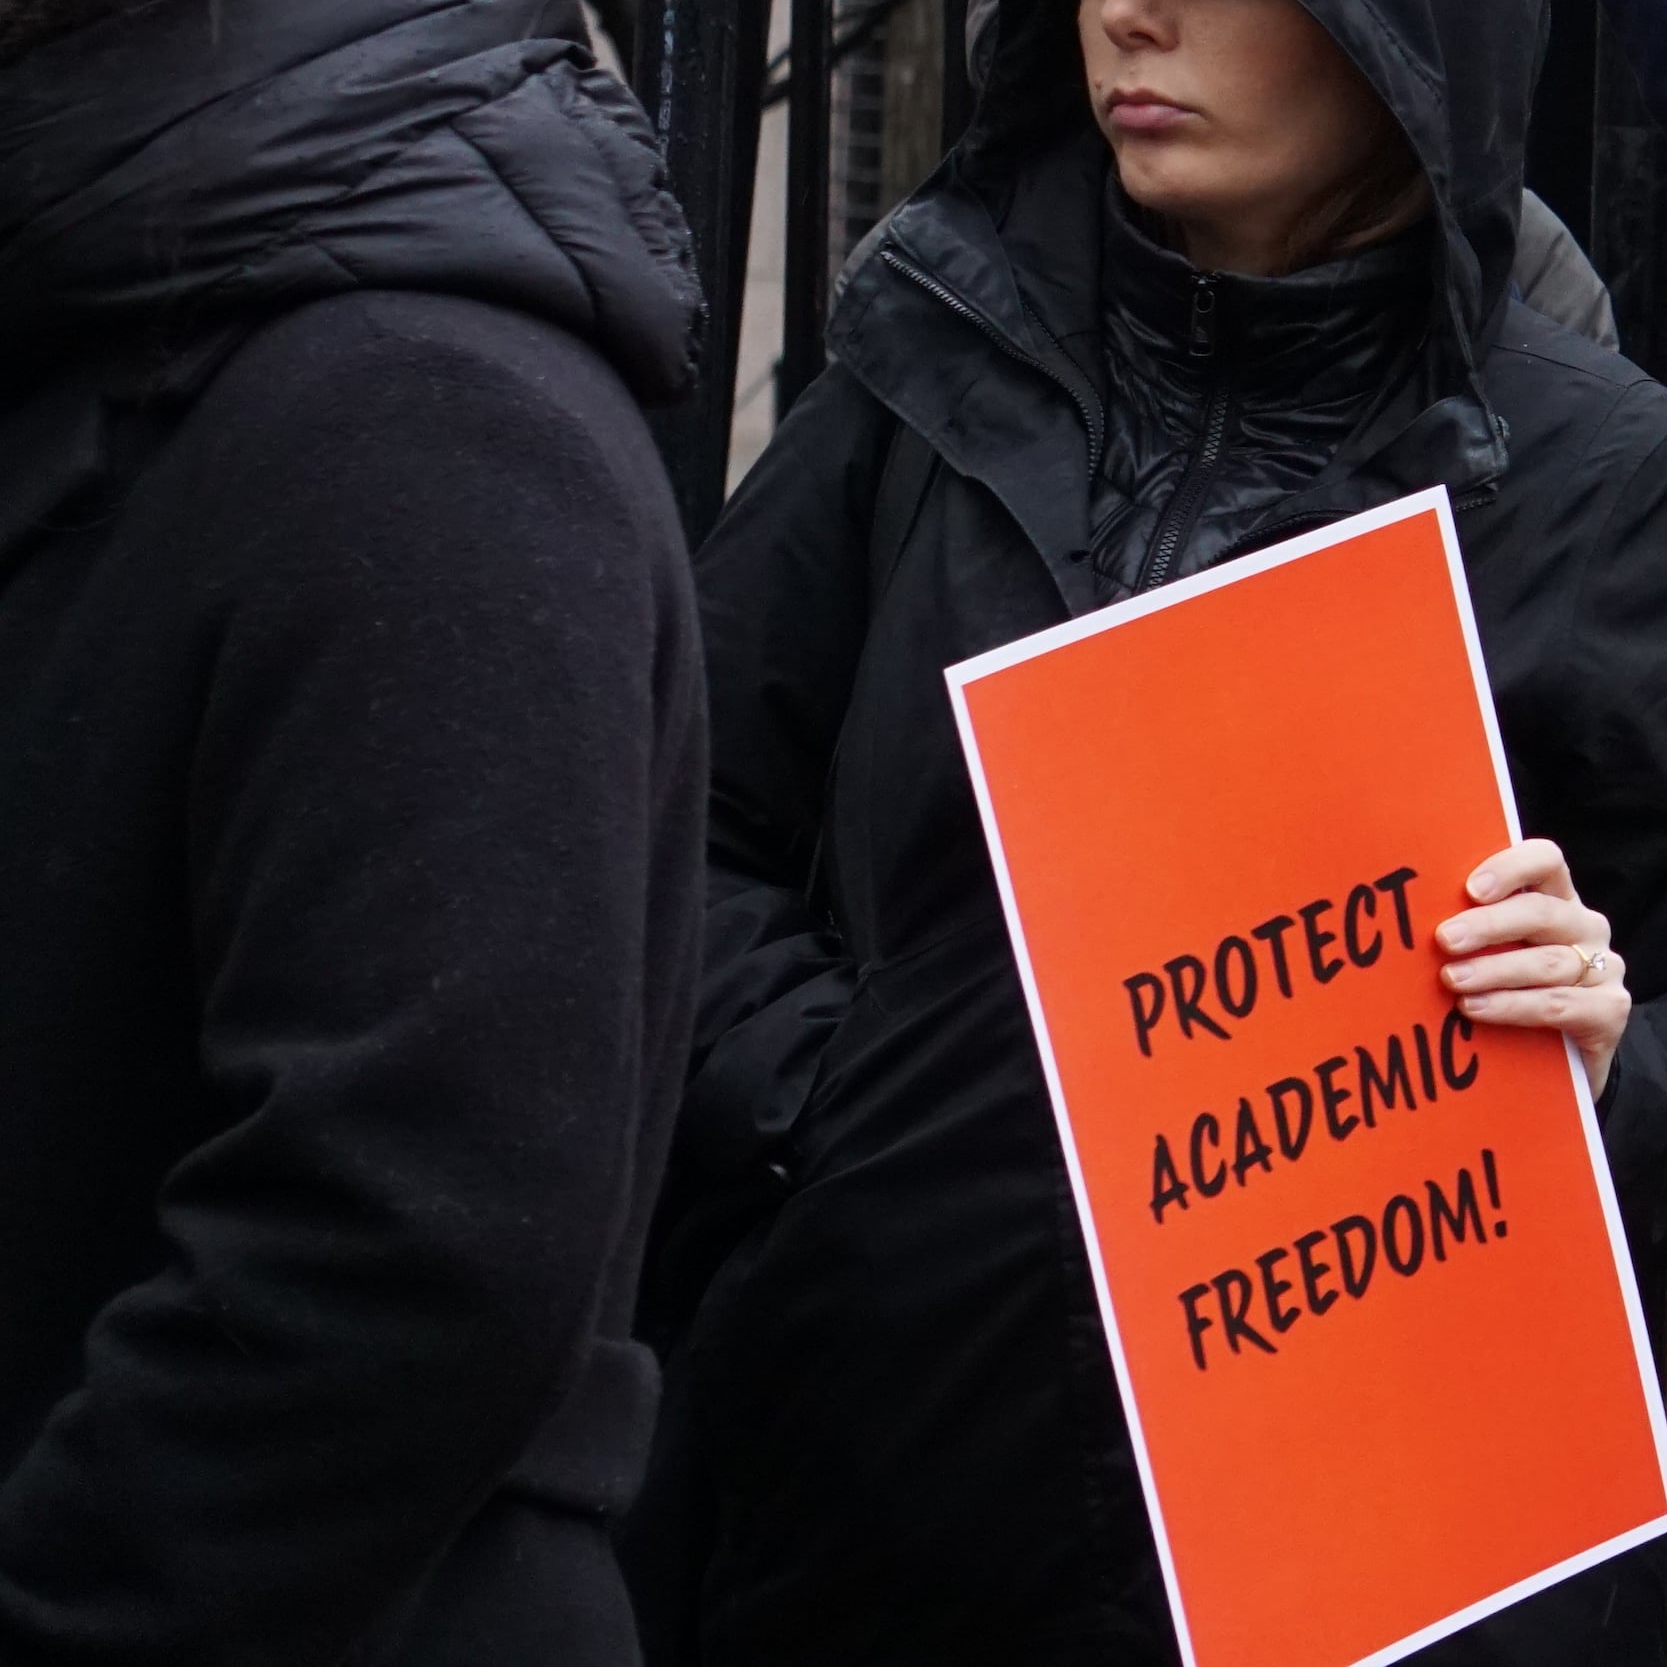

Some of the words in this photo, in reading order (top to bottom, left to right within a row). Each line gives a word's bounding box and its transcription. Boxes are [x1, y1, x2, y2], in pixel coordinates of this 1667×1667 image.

[1123, 866, 1418, 1057] PROTECT
[1149, 1009, 1479, 1224] ACADEMIC
[1178, 1149, 1510, 1371] FREEDOM!
